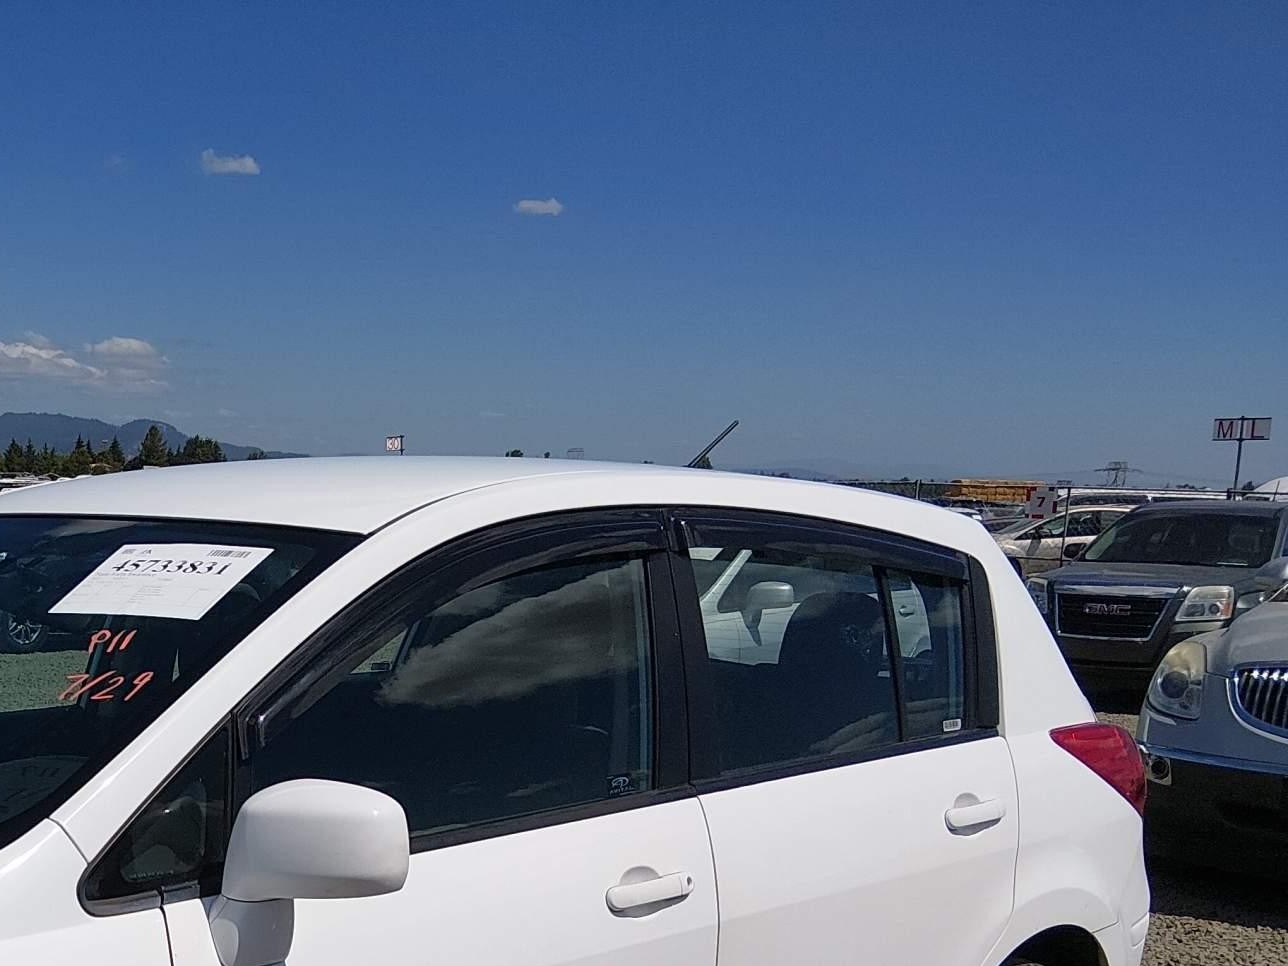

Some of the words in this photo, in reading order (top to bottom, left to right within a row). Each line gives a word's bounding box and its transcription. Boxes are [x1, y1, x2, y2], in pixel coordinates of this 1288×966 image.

[1037, 496, 1046, 508] 7
[111, 559, 232, 575] 45733831
[1085, 602, 1131, 616] GMC
[59, 670, 154, 702] 7/29
